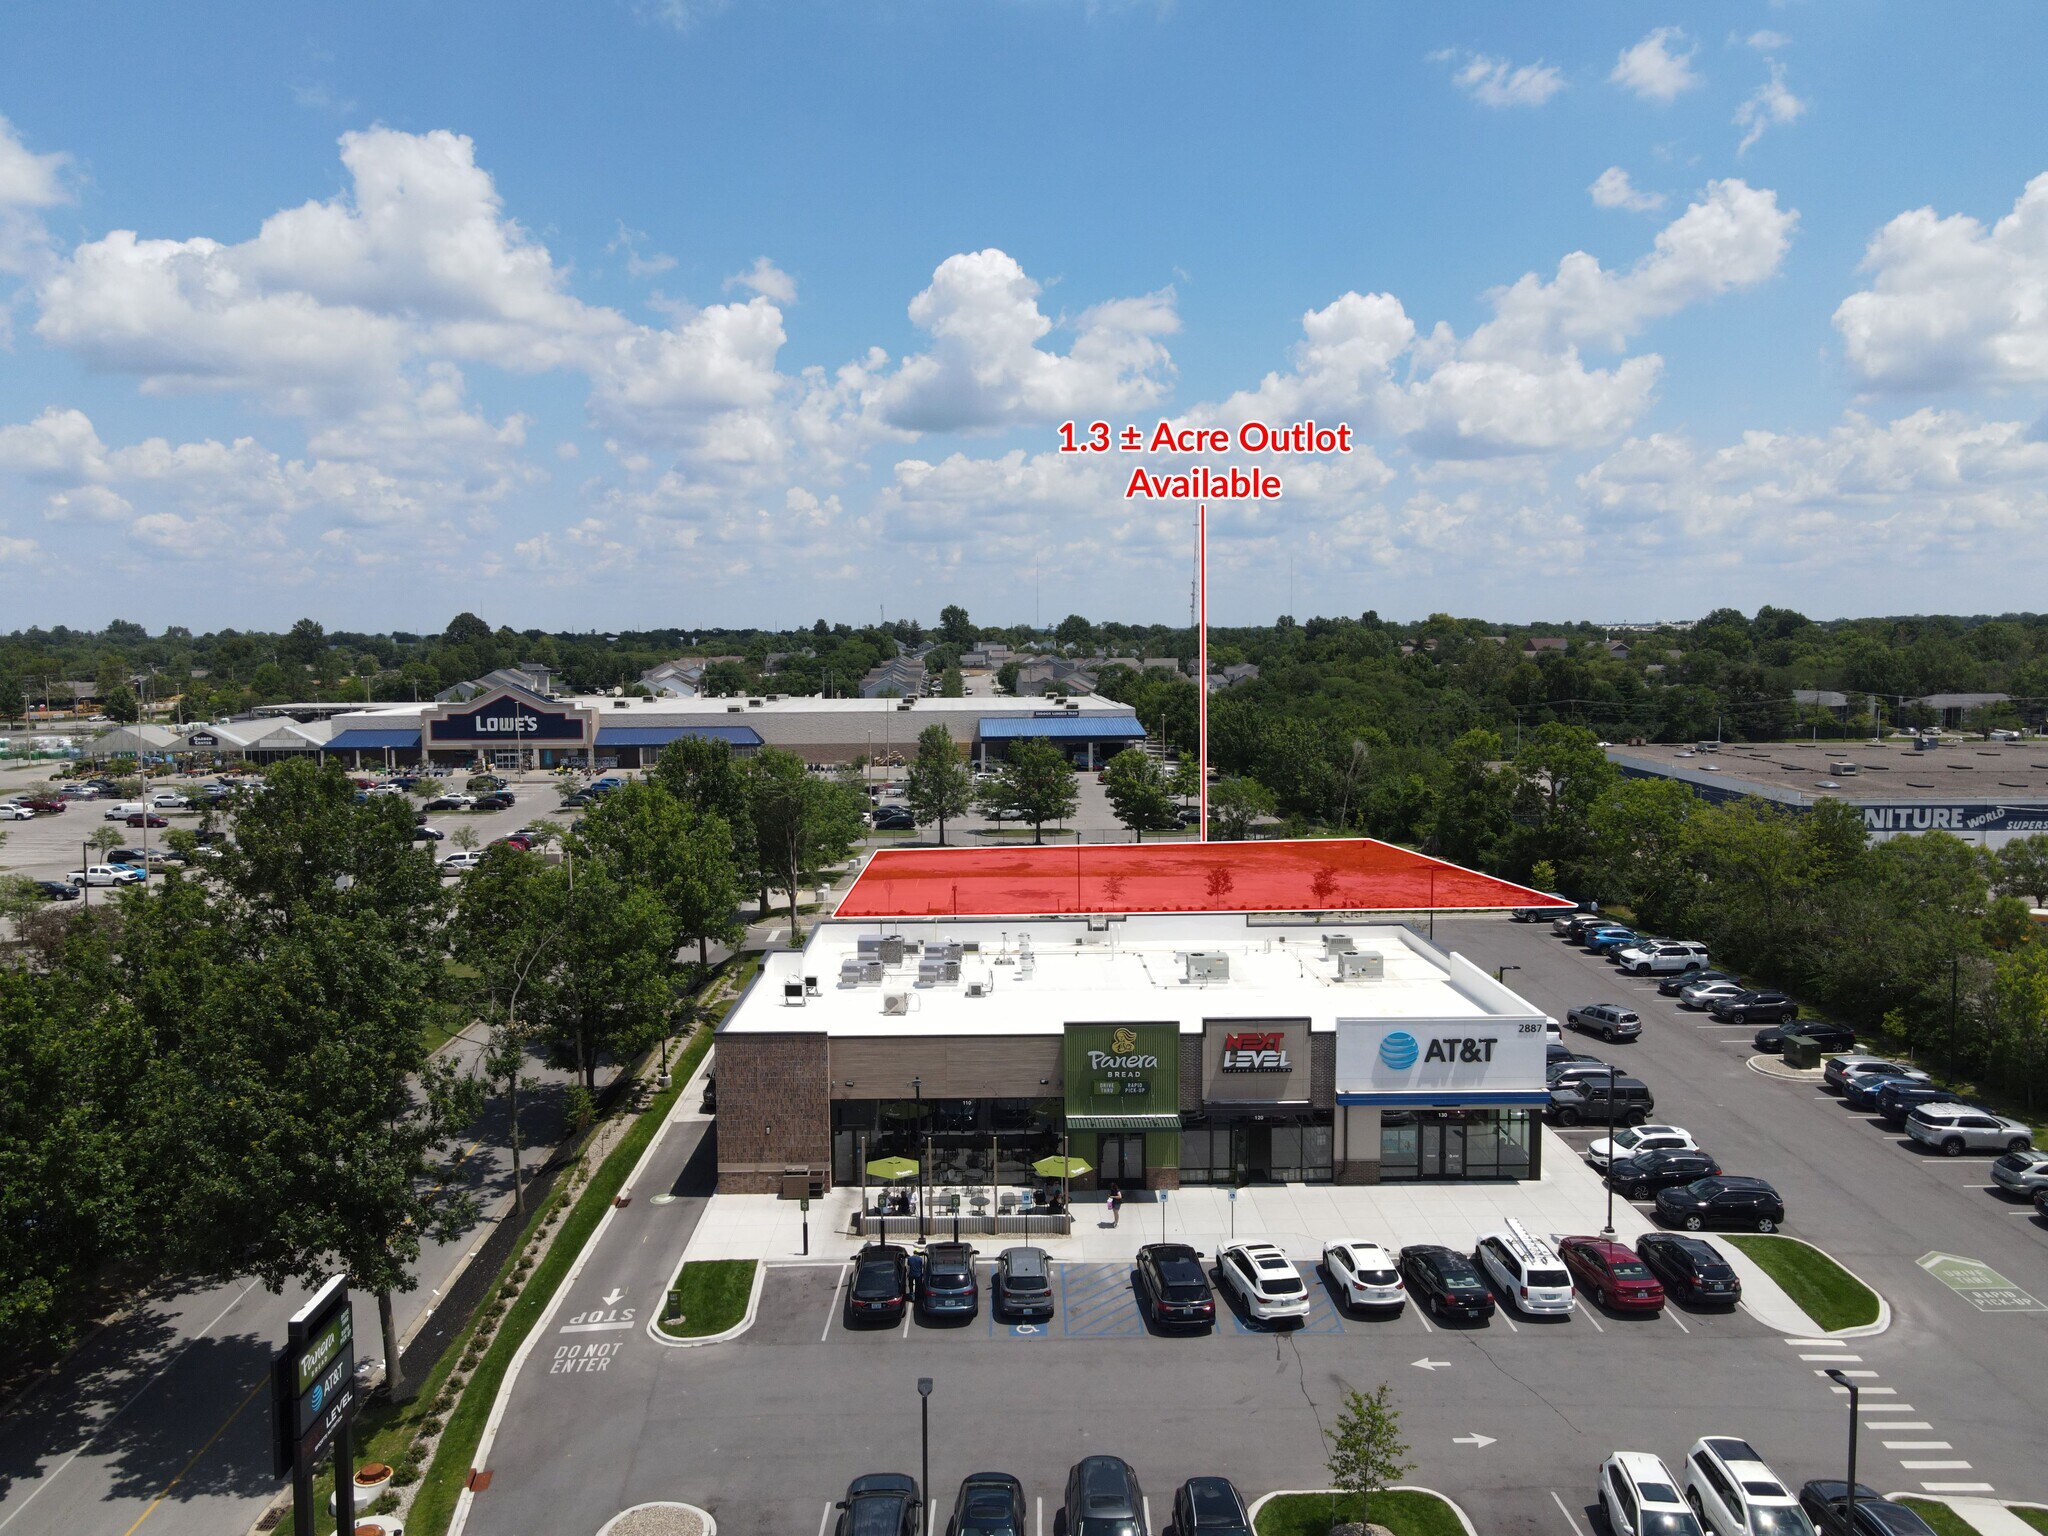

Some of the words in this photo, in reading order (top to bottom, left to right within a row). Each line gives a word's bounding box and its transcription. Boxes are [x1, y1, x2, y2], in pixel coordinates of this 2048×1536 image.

[475, 715, 538, 732] LOWE'S
[1967, 808, 2005, 829] WORLD
[1518, 1024, 1542, 1033] 2887
[1225, 1032, 1284, 1053] NEXT
[1424, 1038, 1498, 1063] AT&T
[1087, 1050, 1157, 1070] Panera
[1223, 1050, 1292, 1069] LEVEL
[569, 1308, 636, 1324] STOP
[301, 1332, 335, 1377] Panera
[553, 1345, 581, 1360] DO
[583, 1342, 624, 1358] NOT
[549, 1357, 611, 1374] ENTER
[324, 1362, 344, 1397] AT&T
[326, 1390, 353, 1429] LEVEL
